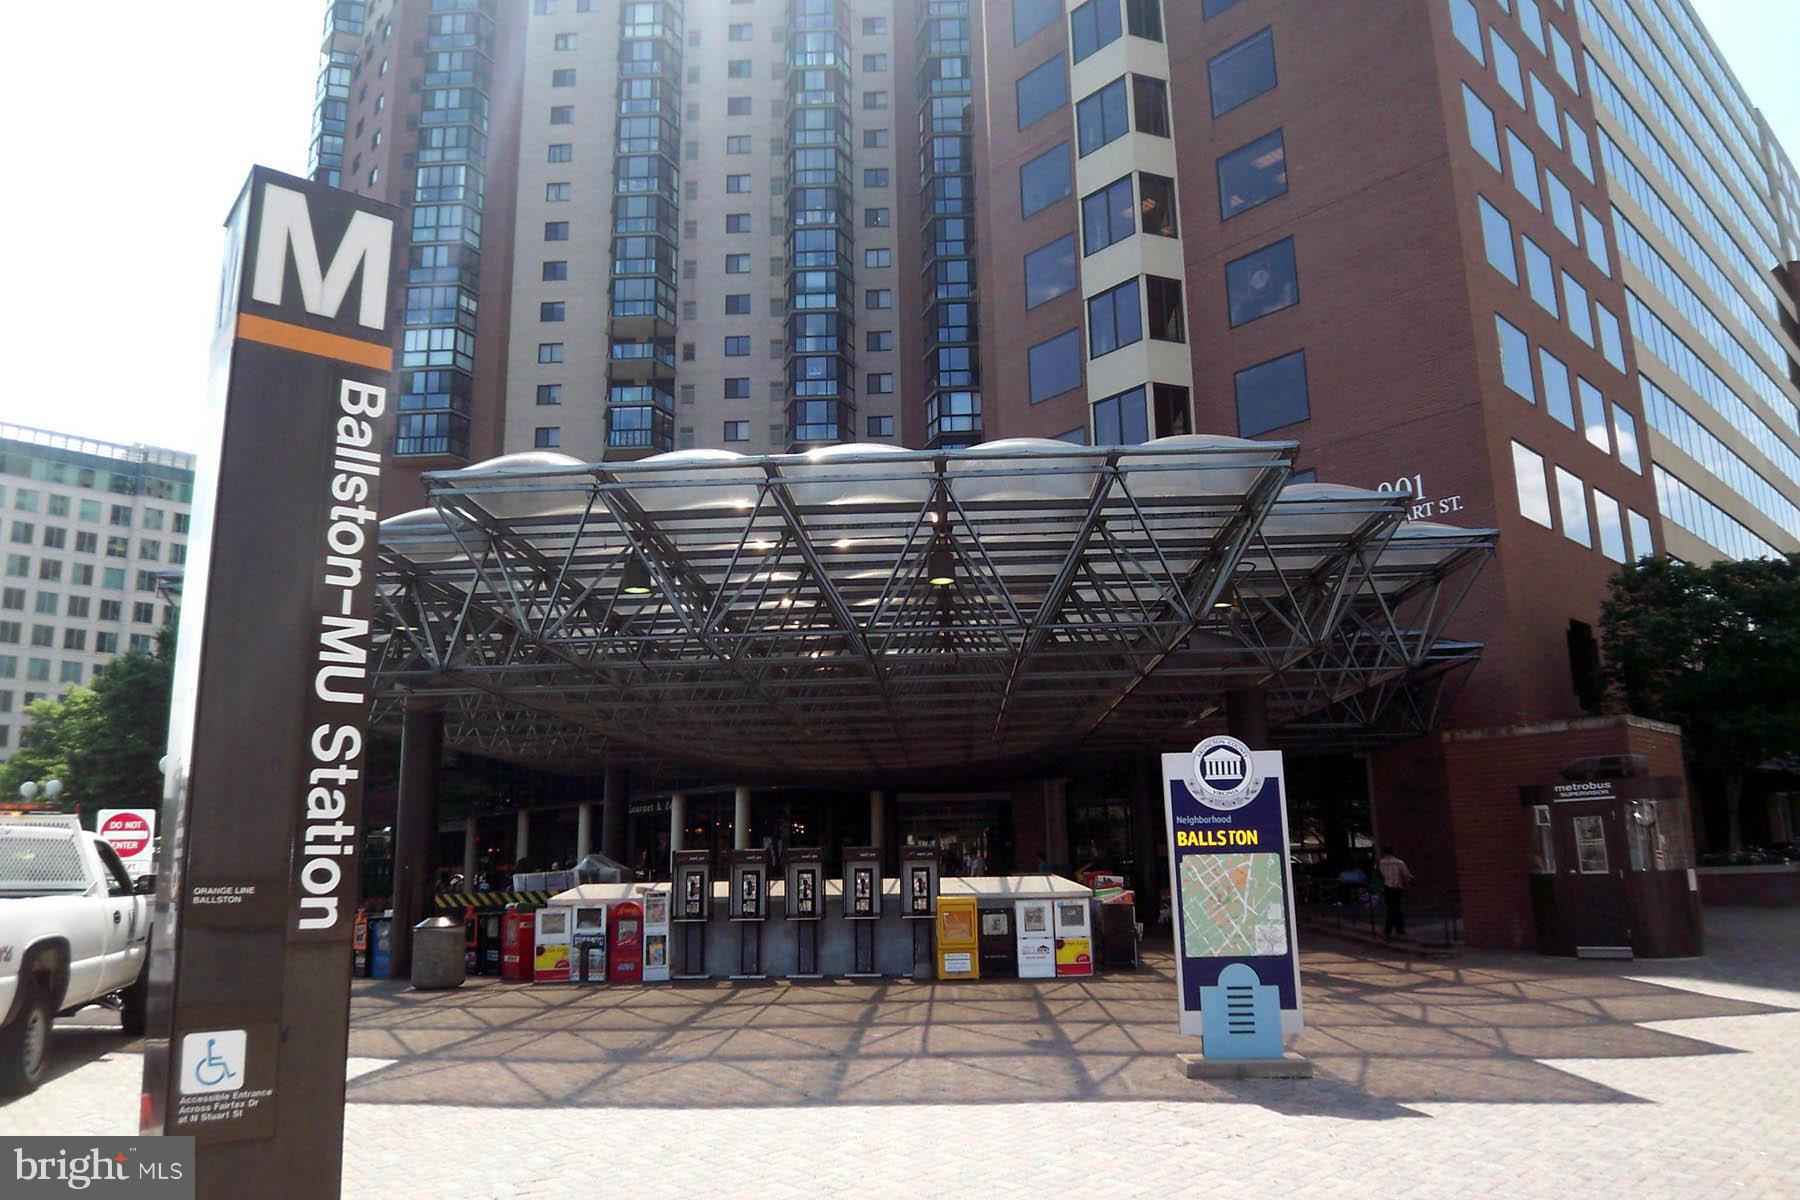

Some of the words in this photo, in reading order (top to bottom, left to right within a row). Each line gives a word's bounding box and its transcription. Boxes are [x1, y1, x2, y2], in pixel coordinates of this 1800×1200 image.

[252, 182, 393, 331] M
[1439, 495, 1464, 513] ST.
[1554, 782, 1612, 792] metrobus
[124, 820, 143, 828] NOT
[298, 723, 362, 930] Station
[1176, 815, 1232, 826] Neighborhood
[1177, 829, 1259, 847] BALLSTON
[193, 886, 233, 896] ORANGE
[234, 886, 256, 895] LINE
[192, 896, 242, 904] BALLSTON
[180, 1093, 230, 1105] Accessible
[232, 1088, 273, 1100] Entrance
[179, 1104, 212, 1114] Across
[213, 1101, 246, 1111] Fairfax
[247, 1099, 259, 1108] Dr
[178, 1116, 187, 1124] at
[201, 1111, 231, 1121] Stuart
[232, 1109, 243, 1119] St
